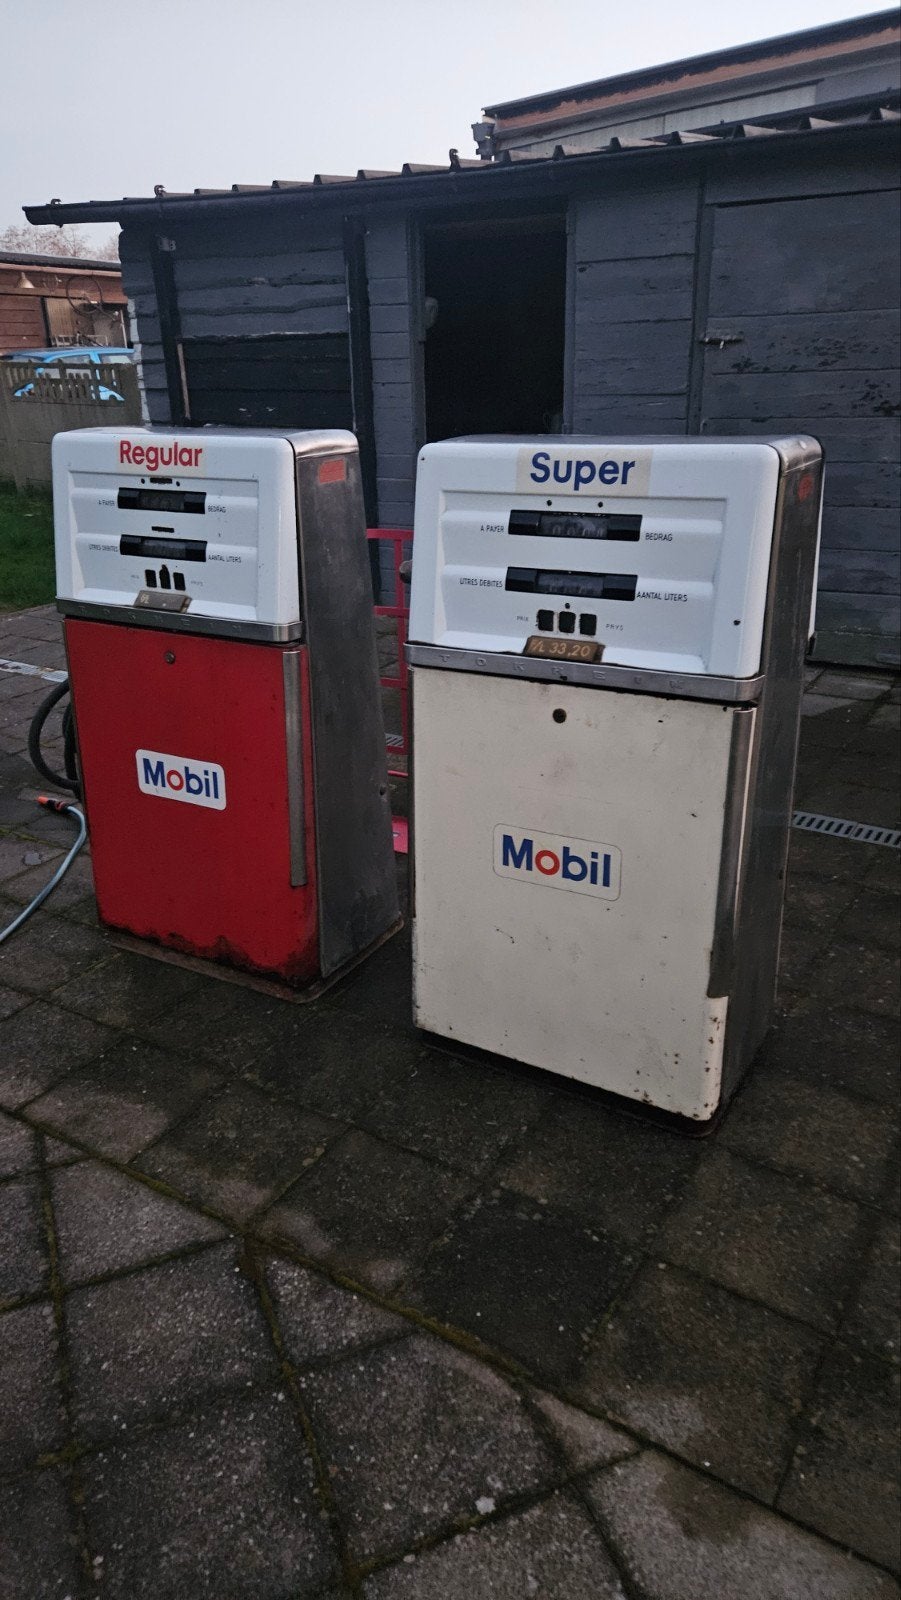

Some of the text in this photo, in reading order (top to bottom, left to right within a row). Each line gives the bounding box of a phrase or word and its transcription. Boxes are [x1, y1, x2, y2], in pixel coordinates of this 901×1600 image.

[120, 440, 203, 471] Regular
[530, 451, 635, 491] Super
[645, 532, 673, 542] BEDRAG
[479, 579, 503, 588] DEBITES
[637, 591, 662, 600] AANTAL
[549, 642, 592, 657] 33,20
[143, 758, 219, 799] Mobil
[502, 834, 611, 887] Mobil
